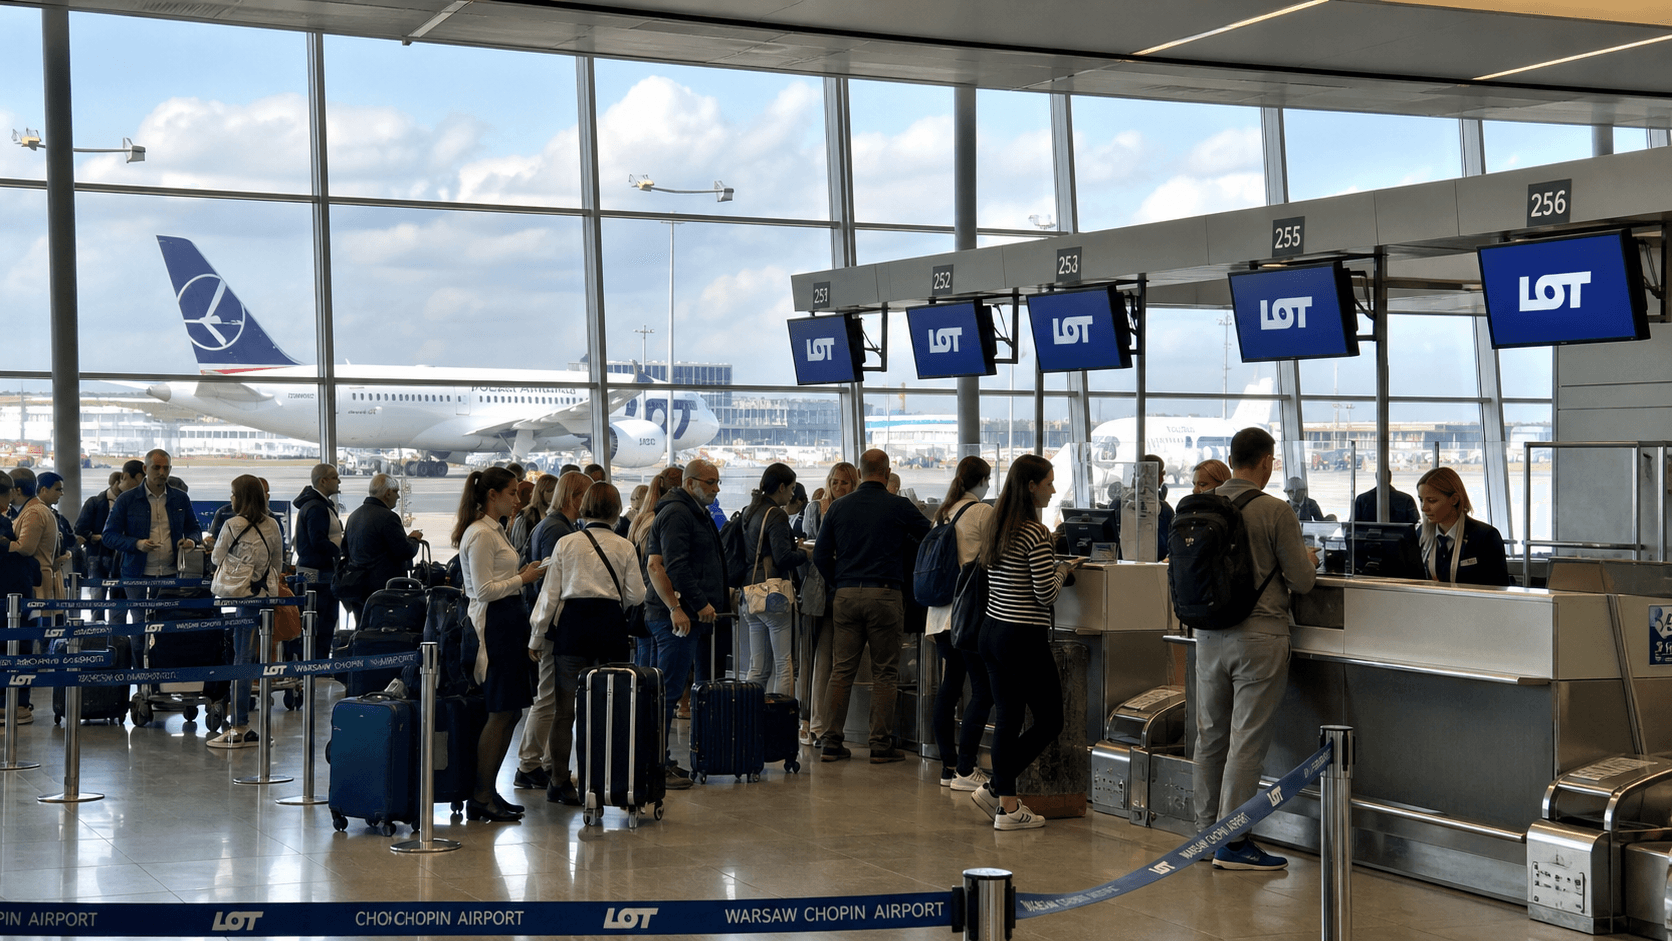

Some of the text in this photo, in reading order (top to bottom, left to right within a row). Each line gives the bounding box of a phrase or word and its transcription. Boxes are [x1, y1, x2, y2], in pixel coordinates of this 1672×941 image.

[1530, 189, 1567, 218] 256
[1274, 225, 1301, 249] 255
[933, 271, 951, 290] 252
[1519, 270, 1592, 312] LOT
[1260, 296, 1313, 331] LOT
[928, 327, 963, 354] LOT
[1052, 315, 1093, 345] LOT
[806, 337, 835, 362] LOT
[44, 628, 66, 638] LOT
[144, 623, 165, 633] LOT
[8, 674, 37, 686] LOT
[262, 665, 288, 676] LOT
[1266, 785, 1284, 808] LOT
[1148, 860, 1176, 876] LOT
[28, 911, 98, 927] AIRPORT
[211, 911, 264, 931] LOT
[394, 911, 451, 926] CHOPIN
[457, 910, 525, 926] AIRPORT
[603, 907, 659, 929] LOT
[725, 907, 798, 925] WARSAW
[804, 904, 867, 923] CHOPIN
[874, 901, 945, 920] AIRPORT
